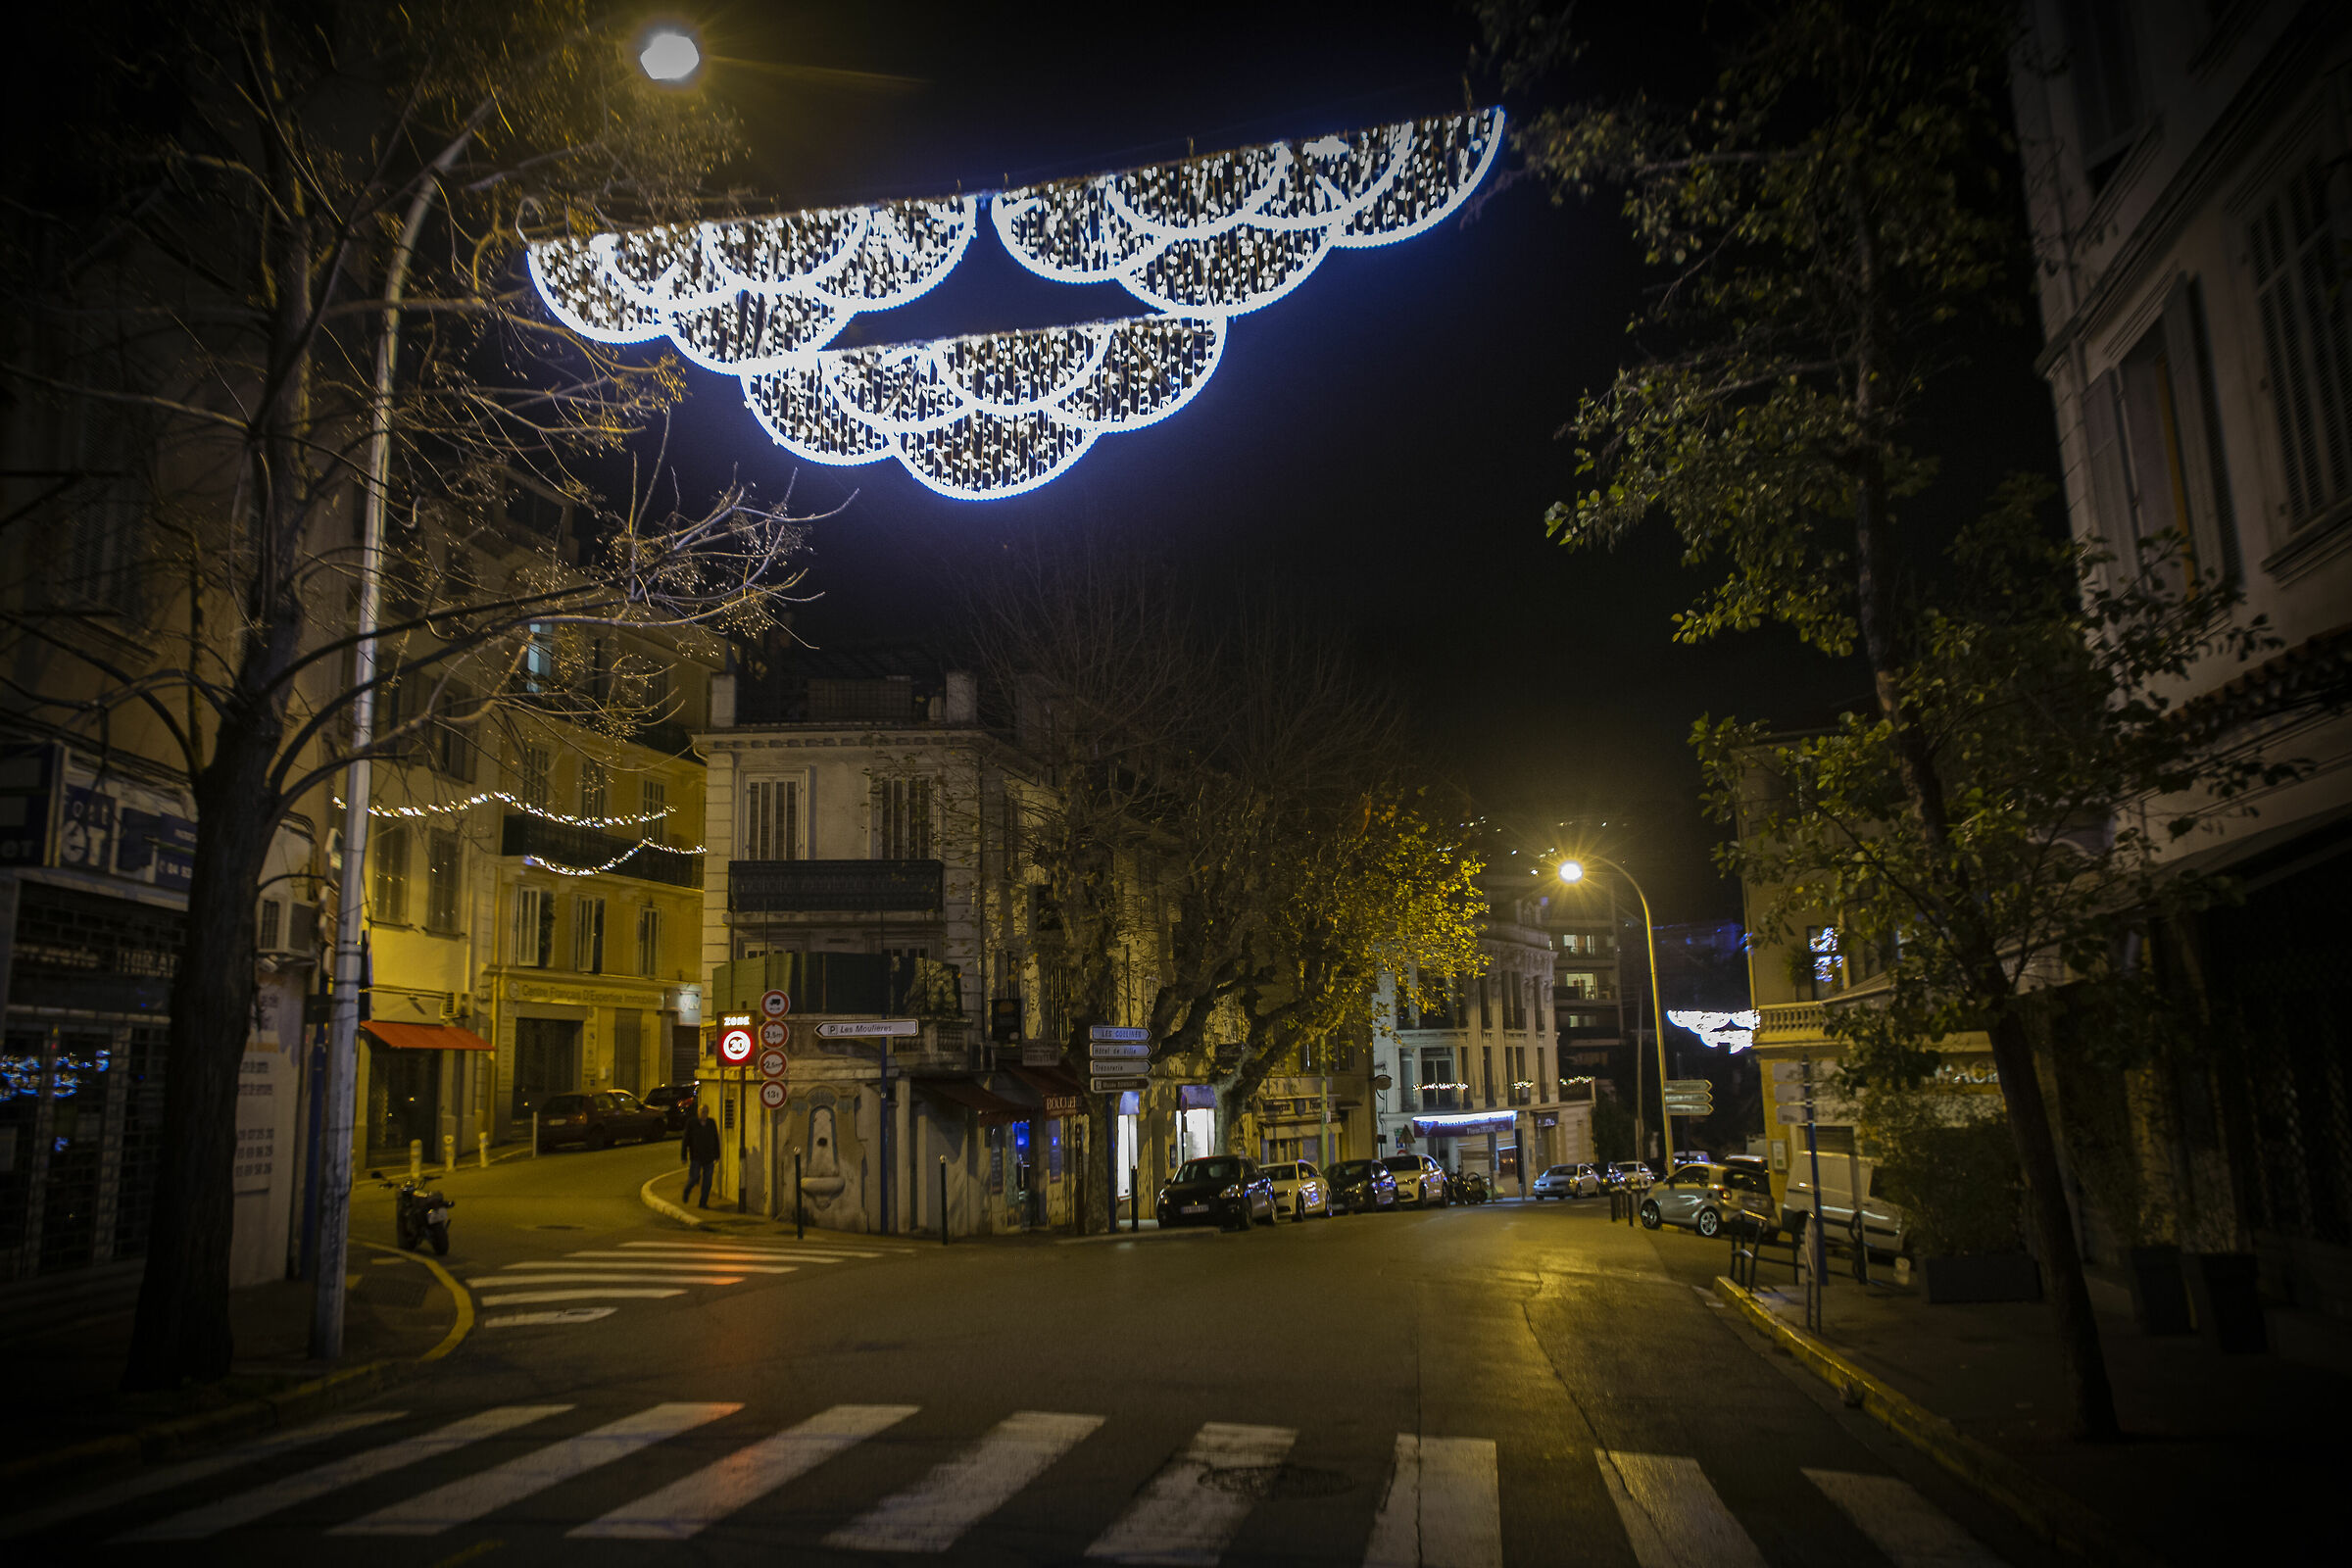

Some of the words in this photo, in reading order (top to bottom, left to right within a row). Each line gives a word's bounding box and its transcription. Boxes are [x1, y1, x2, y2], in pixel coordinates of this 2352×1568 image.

[724, 1016, 750, 1026] ZONE
[856, 1024, 892, 1033] Moulières
[729, 1039, 745, 1052] 30
